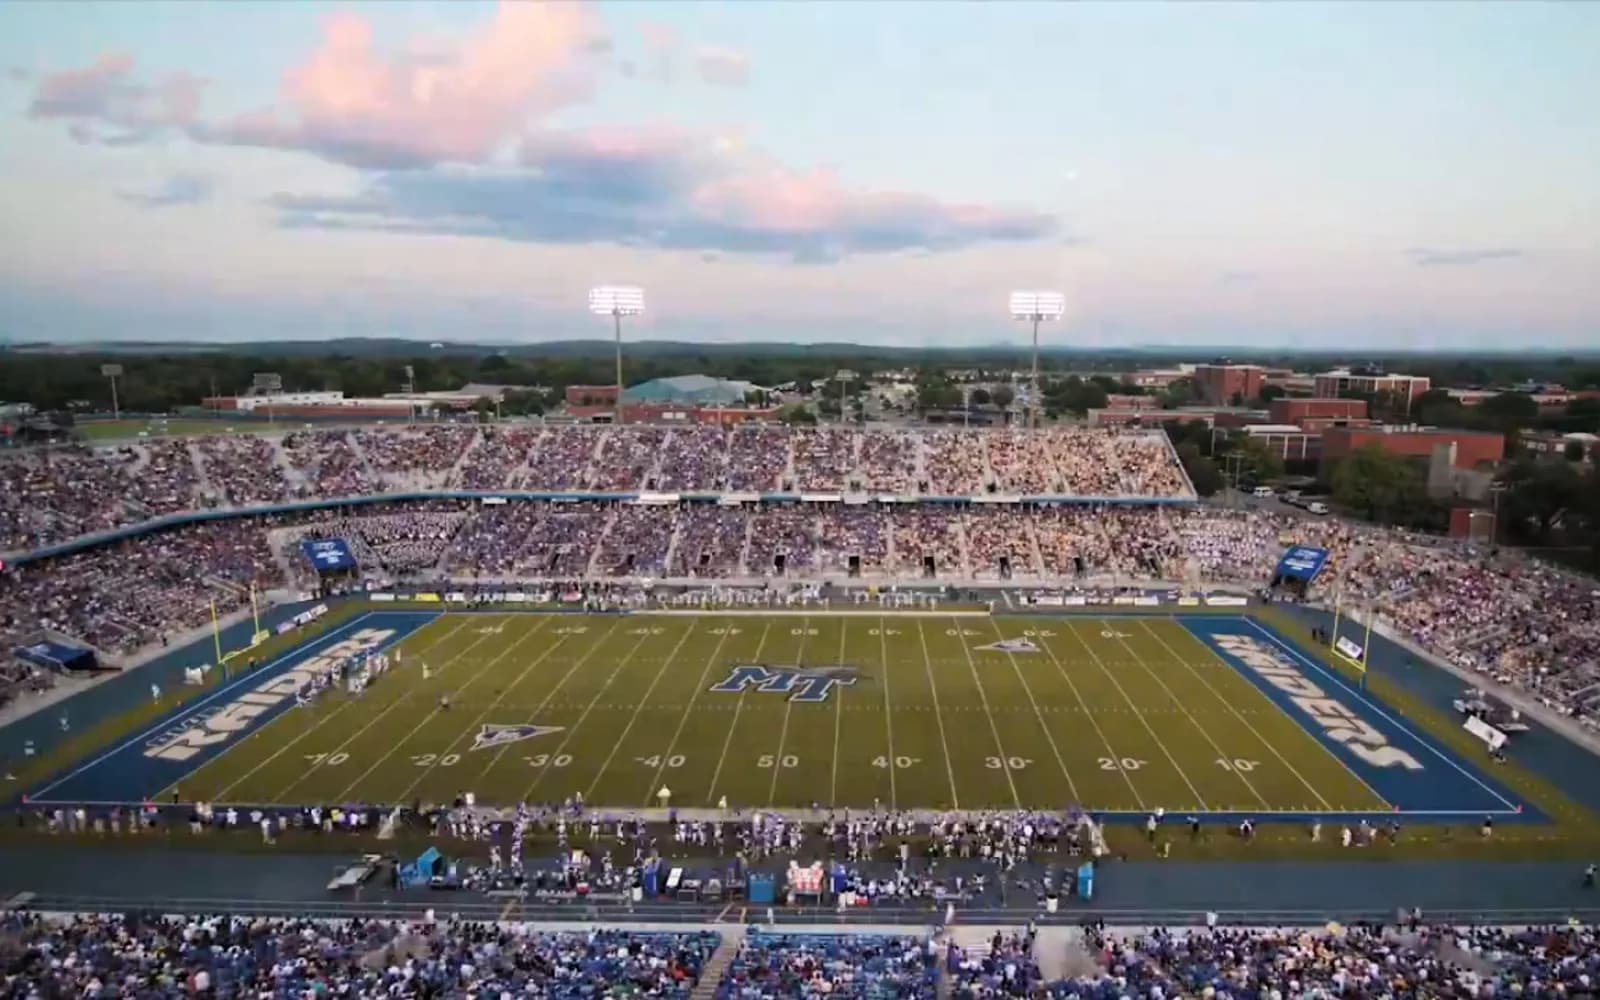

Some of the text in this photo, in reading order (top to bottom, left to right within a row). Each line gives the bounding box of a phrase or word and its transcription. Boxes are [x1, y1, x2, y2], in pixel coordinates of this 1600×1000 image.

[709, 666, 857, 702] MT
[1211, 633, 1425, 769] RAIDERS
[310, 752, 350, 765] 10
[418, 752, 461, 766] 20
[529, 753, 573, 767] 30
[643, 754, 687, 768] 40
[757, 755, 799, 768] 50
[871, 755, 913, 769] 40
[984, 755, 1027, 769] 30
[1097, 756, 1140, 771] 20
[1214, 757, 1254, 772] 10
